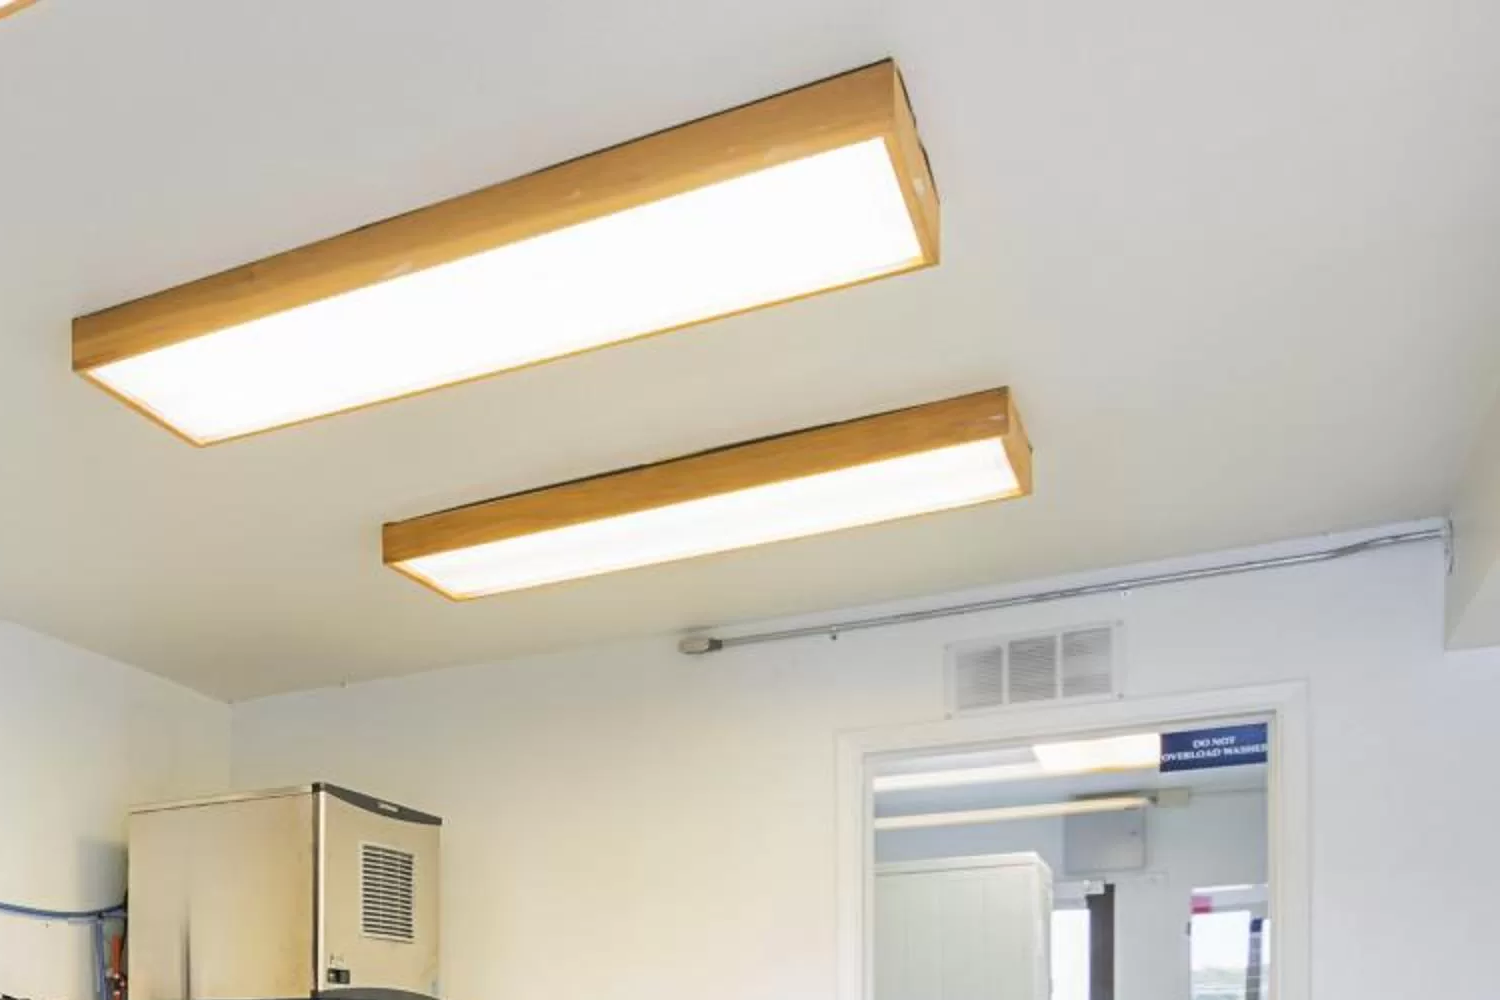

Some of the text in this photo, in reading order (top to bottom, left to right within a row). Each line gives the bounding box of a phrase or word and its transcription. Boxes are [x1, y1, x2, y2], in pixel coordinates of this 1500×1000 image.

[1192, 735, 1237, 749] DO NOT
[1161, 747, 1221, 762] OVERLOAD
